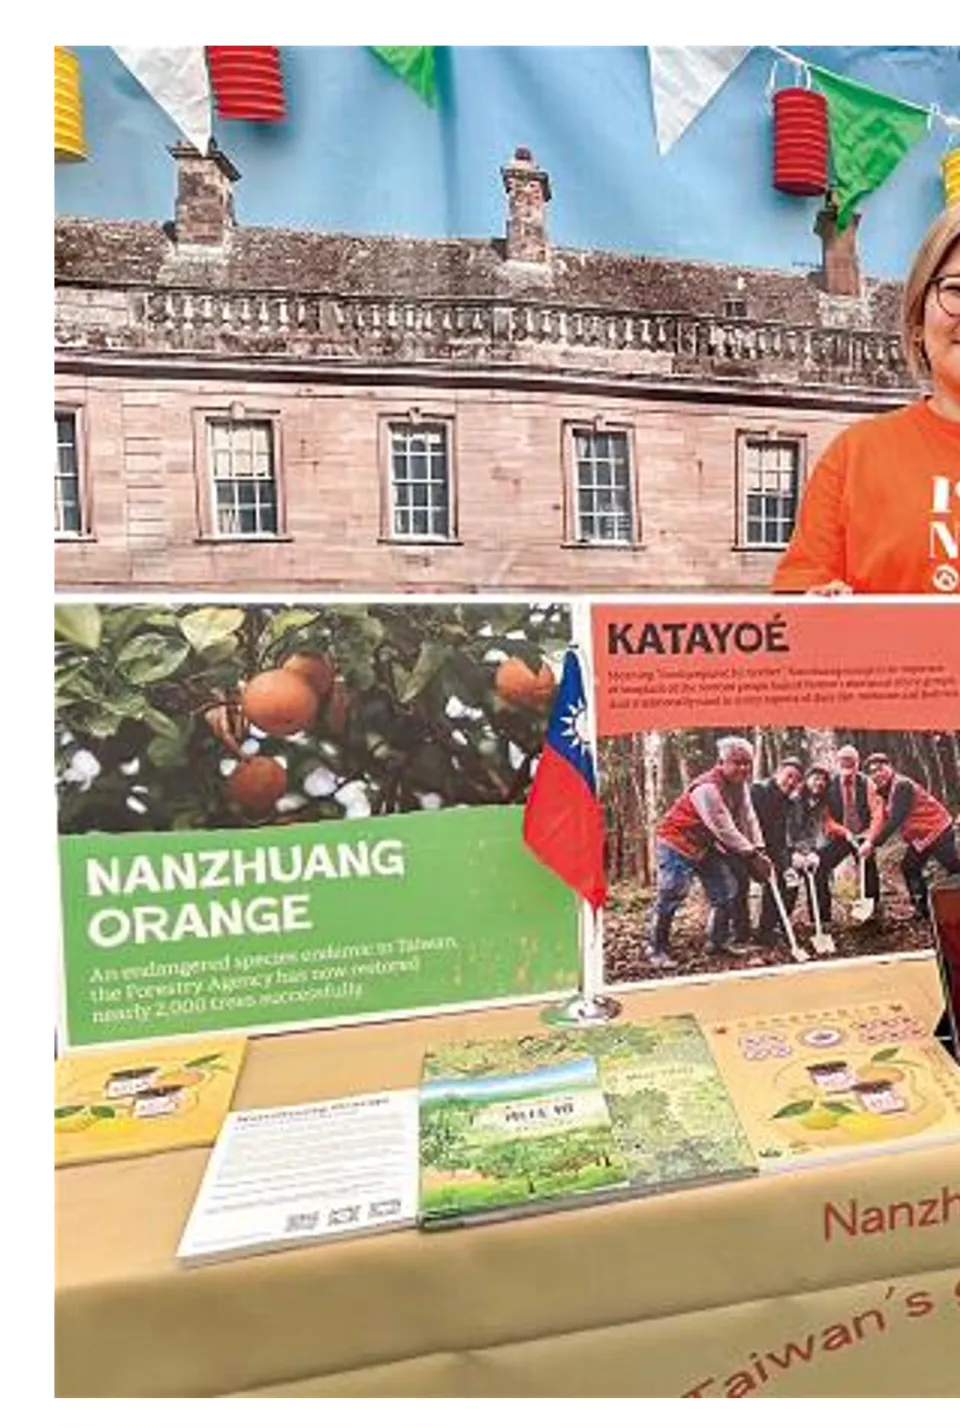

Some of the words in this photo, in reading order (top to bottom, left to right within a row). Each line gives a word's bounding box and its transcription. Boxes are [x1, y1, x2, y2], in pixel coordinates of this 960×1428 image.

[929, 476, 952, 514] I
[607, 613, 789, 656] KATAYOÉ
[87, 839, 405, 896] NANZHUANG
[87, 894, 313, 949] ORANGE
[90, 985, 121, 1003] the
[125, 980, 202, 1002] Forestry
